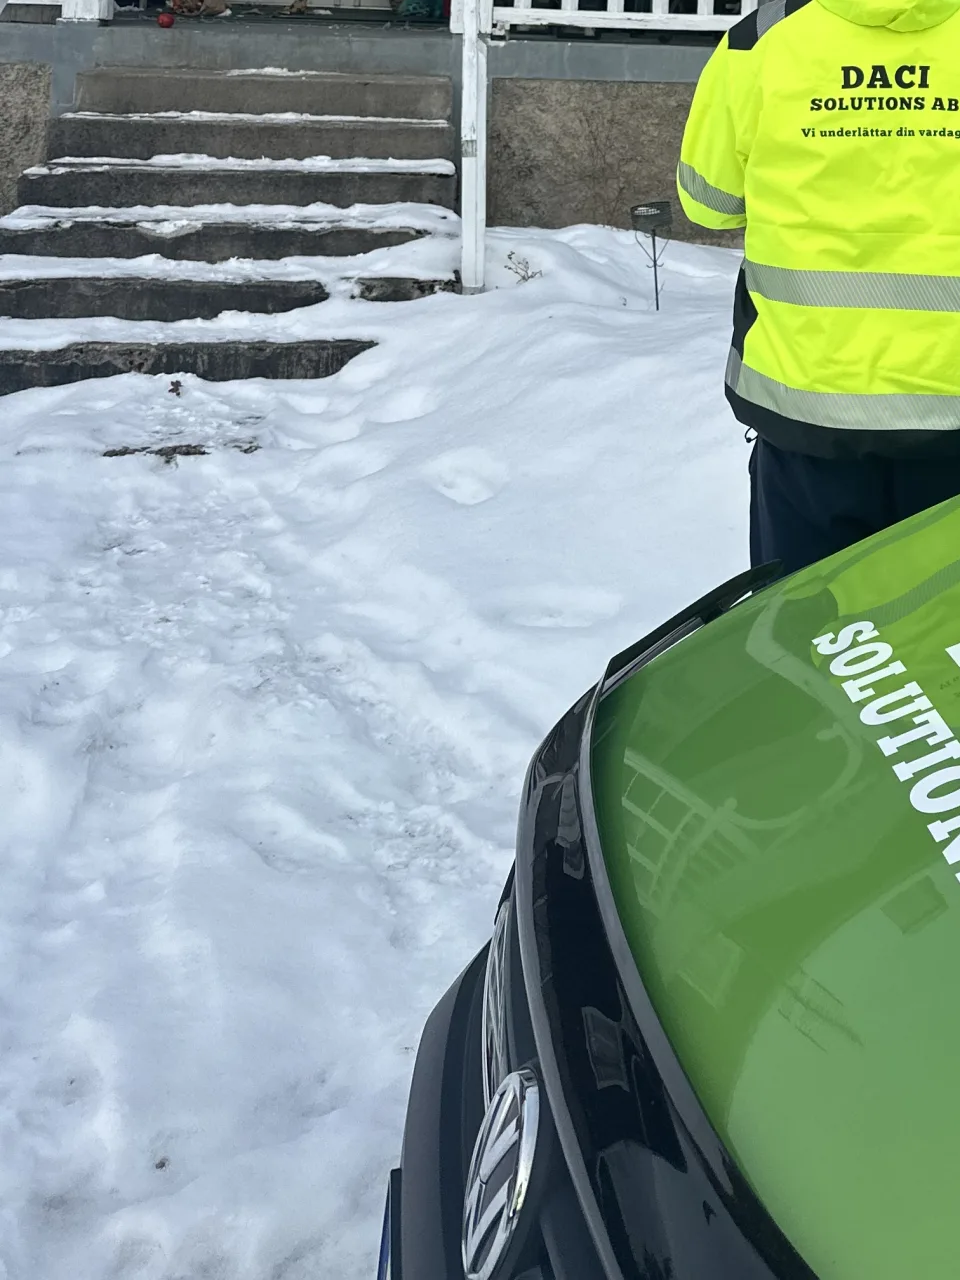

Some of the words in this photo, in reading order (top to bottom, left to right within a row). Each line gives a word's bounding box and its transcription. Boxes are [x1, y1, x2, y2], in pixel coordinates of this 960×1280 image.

[841, 64, 931, 90] DACI
[810, 96, 925, 112] SOLUTIONS
[931, 97, 960, 112] AB
[801, 127, 816, 138] Vi
[819, 126, 893, 138] underlättar
[896, 126, 916, 137] din
